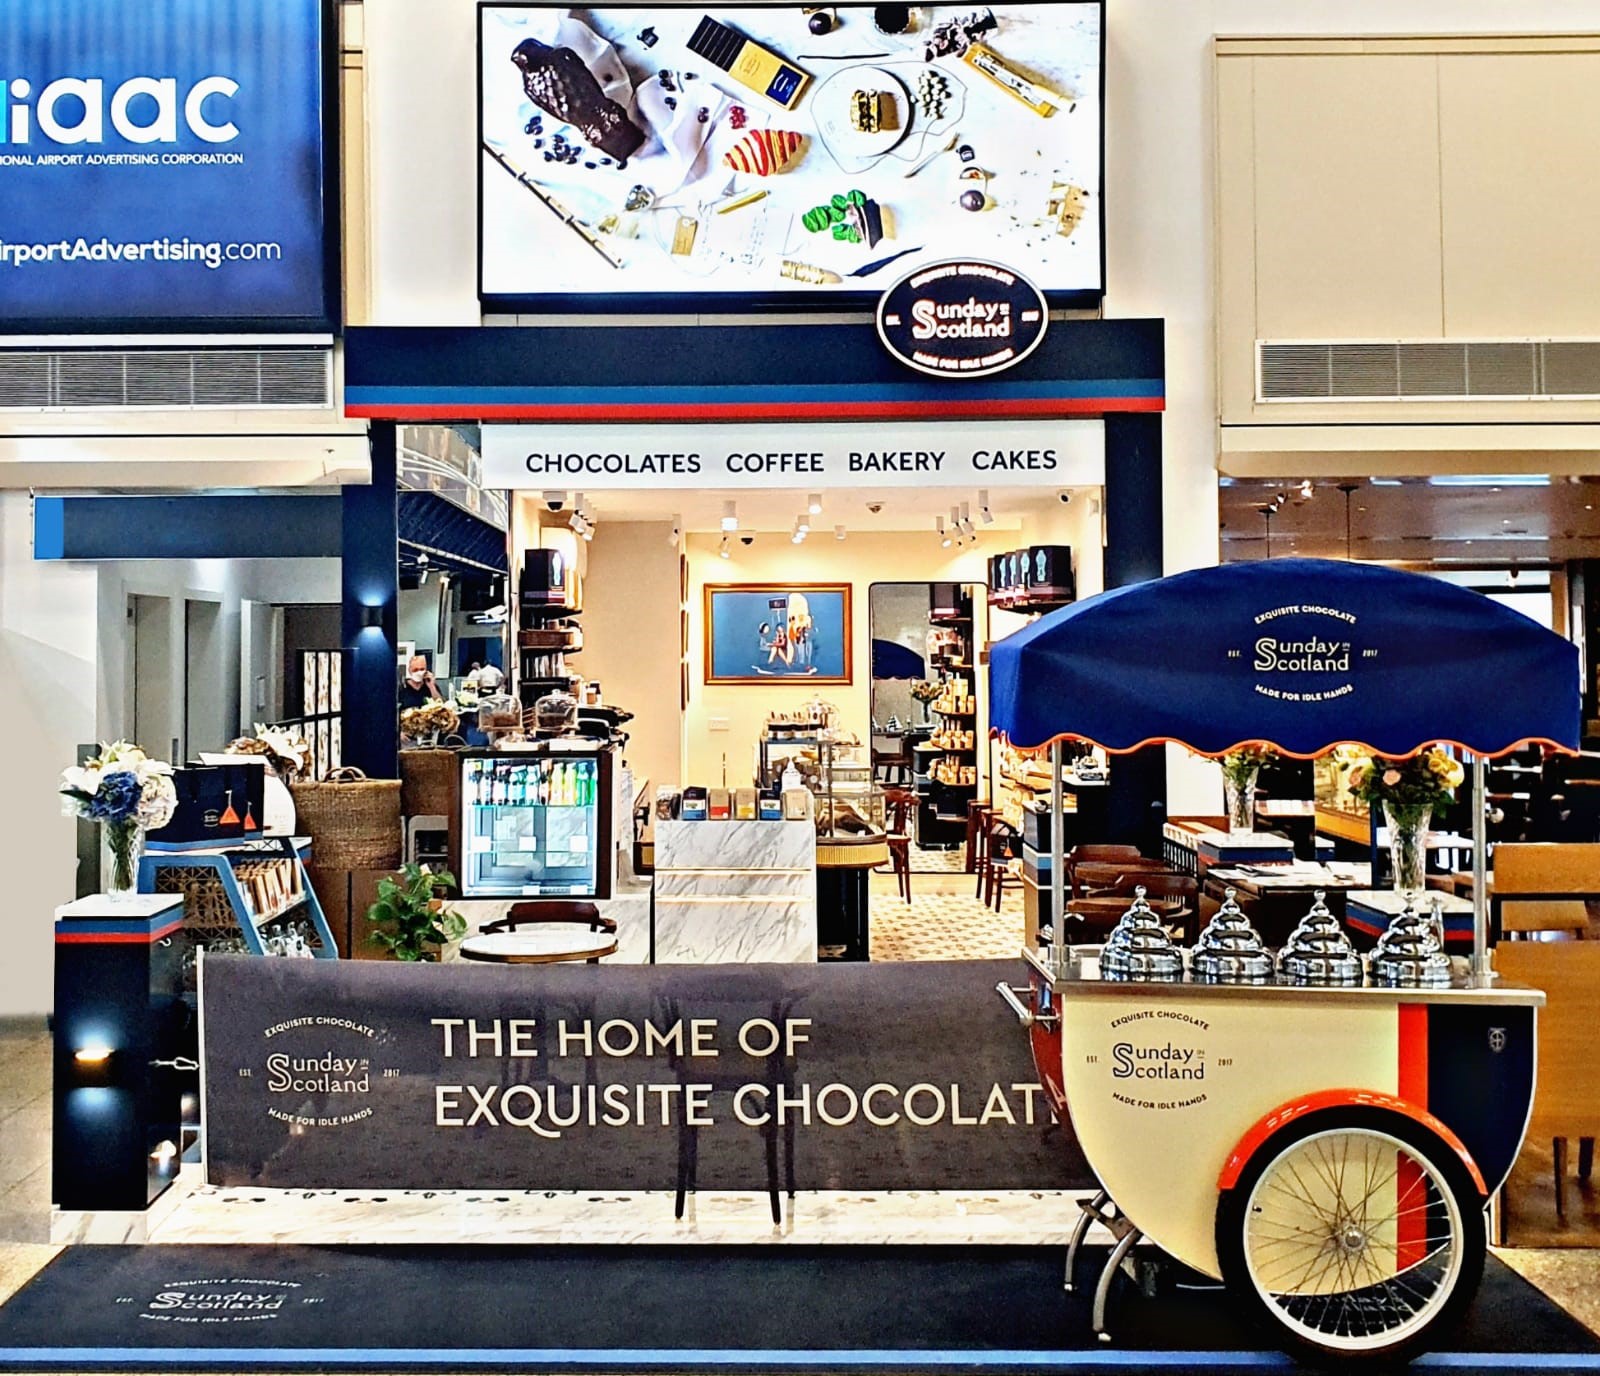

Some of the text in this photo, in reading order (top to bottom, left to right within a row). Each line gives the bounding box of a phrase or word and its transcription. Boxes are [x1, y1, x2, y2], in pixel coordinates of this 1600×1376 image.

[37, 154, 83, 165] AIRPORT
[86, 154, 159, 165] ADVERTISING
[162, 153, 243, 164] CORPORATION
[912, 297, 998, 325] Sunday
[912, 312, 1010, 339] Scotland
[525, 450, 1058, 474] CHOCOLATES COFFEE BAKERY CAKES
[1254, 605, 1357, 624] EXQUISITE CHOCOLATE
[1255, 636, 1339, 659] Sunday
[1254, 649, 1349, 671] Scotland
[1255, 684, 1353, 702] MADE FOR IDLE HANDS
[264, 1016, 375, 1038] EXQUISITE CHOCOLATE
[1110, 1010, 1210, 1030] EXQUISITE CHOCOLATE
[431, 1018, 812, 1057] THE HOME OF
[267, 1052, 358, 1079] Sunday
[1113, 1042, 1194, 1067] Sunday
[383, 1068, 400, 1078] 2017
[1112, 1058, 1205, 1079] Scotland
[267, 1069, 369, 1093] Scotland
[435, 1083, 1059, 1138] EXQUISITE CHOCOLAT
[1112, 1092, 1207, 1110] MADE FOR IDLE HANDS
[268, 1107, 373, 1126] MADE FOR IDLE HANDS
[152, 1291, 272, 1303] Sunday
